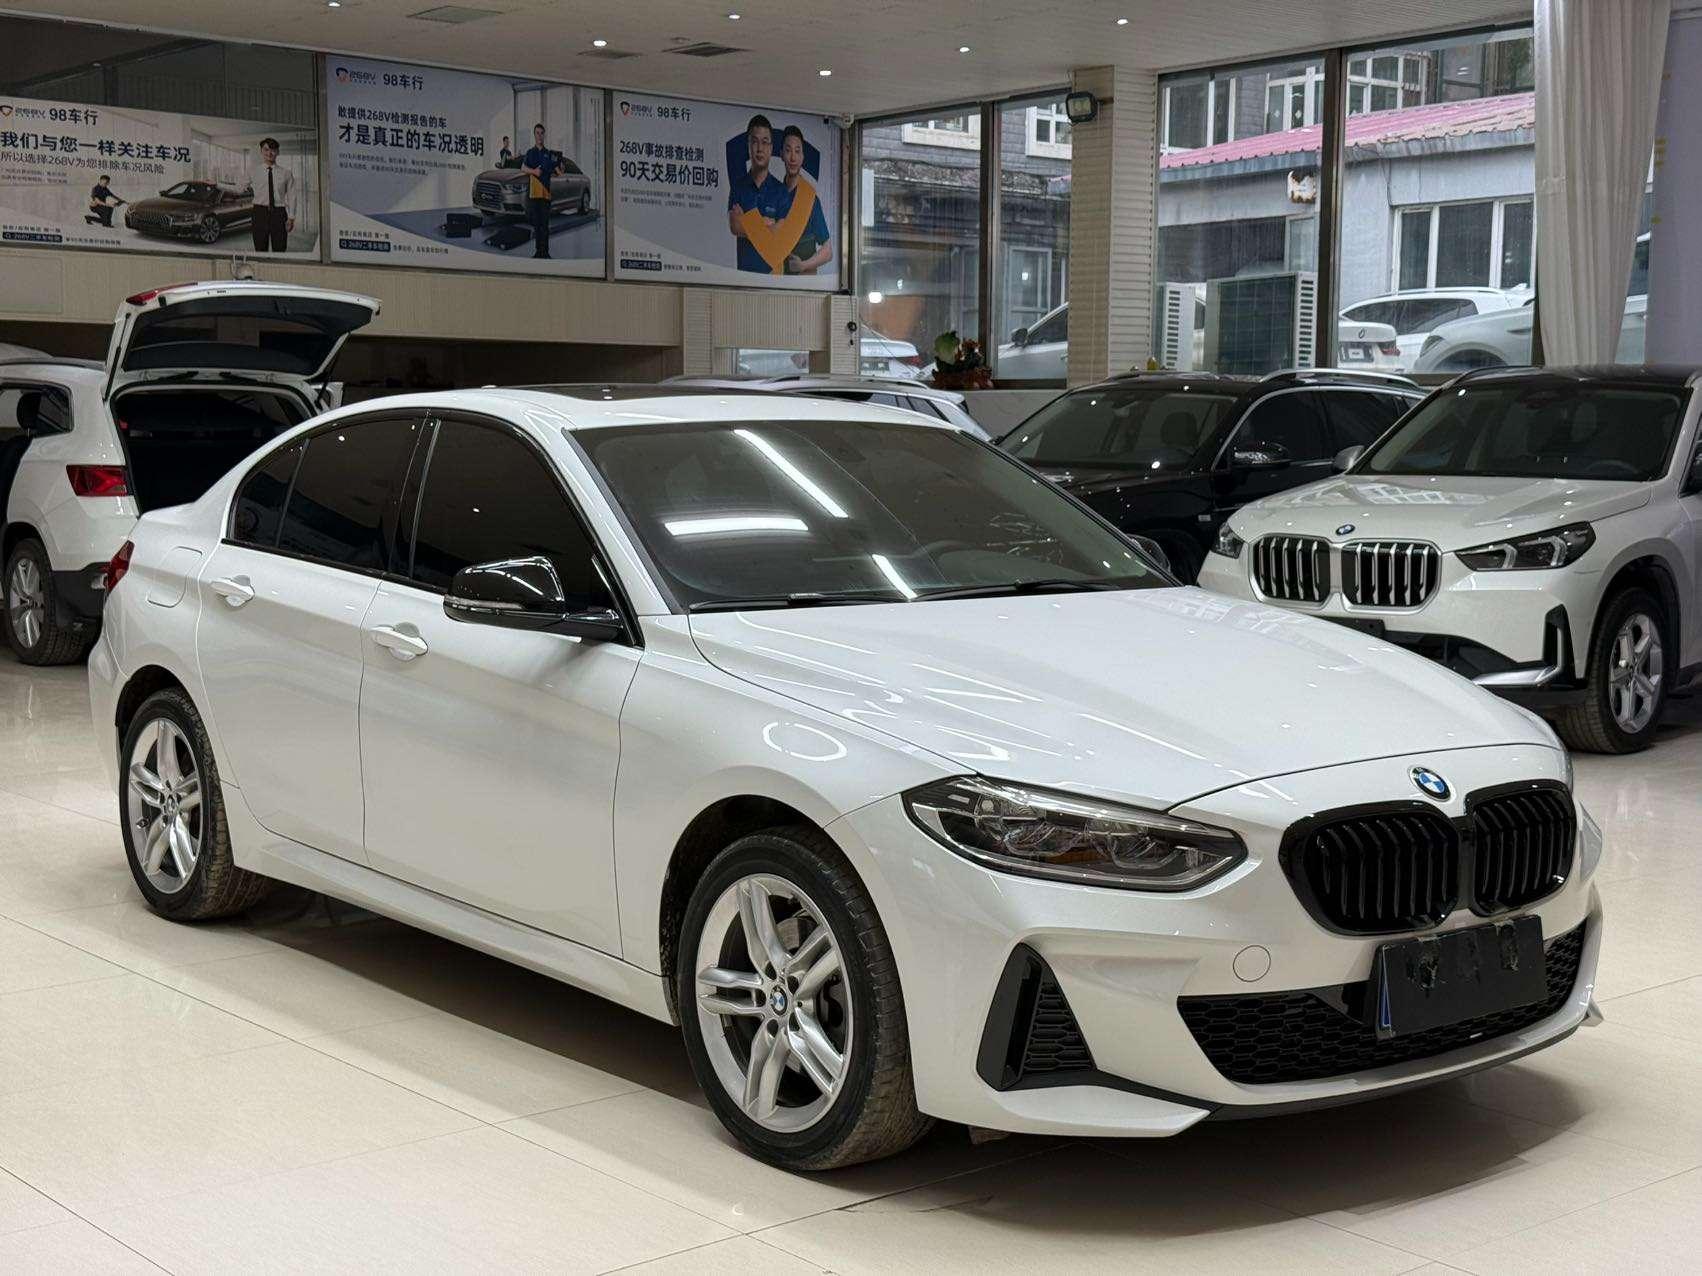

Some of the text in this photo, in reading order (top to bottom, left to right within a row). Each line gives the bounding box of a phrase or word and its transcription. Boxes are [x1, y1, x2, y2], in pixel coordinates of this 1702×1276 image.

[383, 73, 424, 90] 98车行
[49, 108, 98, 126] 98车行
[657, 106, 691, 122] 98车行
[0, 130, 191, 163] 我们与您一样关注车况
[338, 122, 484, 157] 才是真正的车况透明
[0, 151, 165, 174] 所以选择268V为您排除车况风险
[620, 140, 705, 163] 268V事故排查检测
[620, 160, 720, 188] 90天交易价回购
